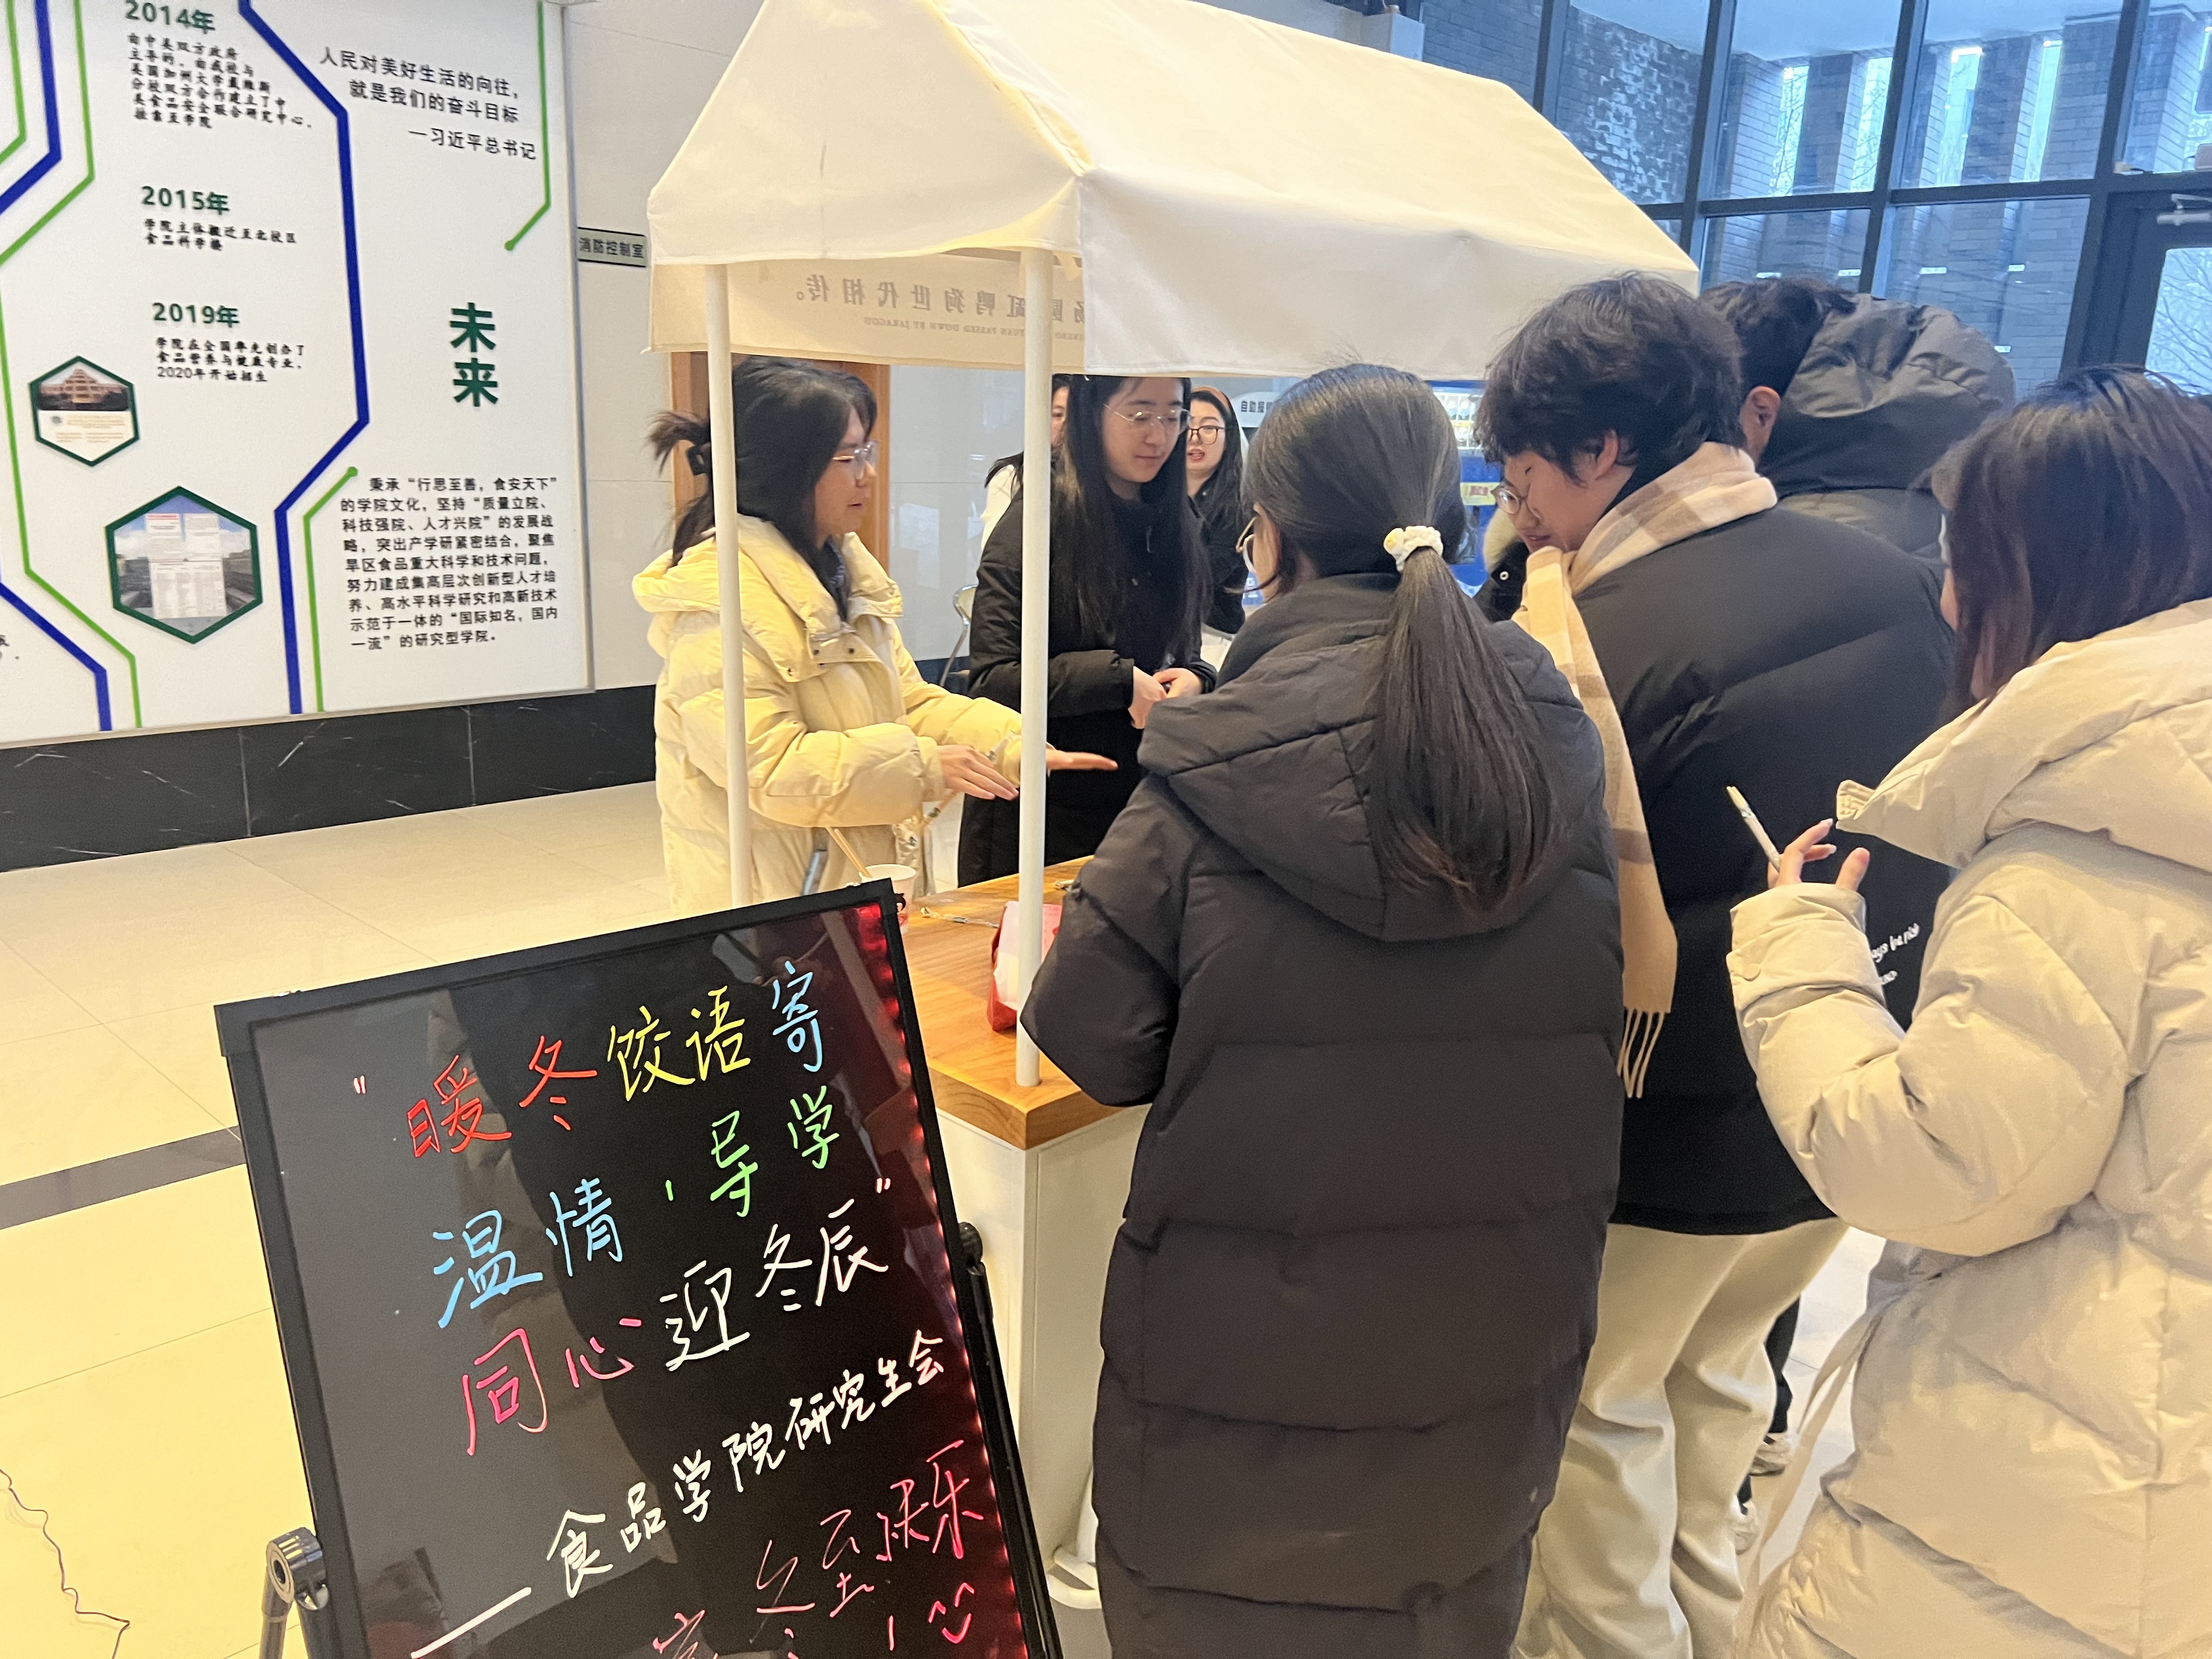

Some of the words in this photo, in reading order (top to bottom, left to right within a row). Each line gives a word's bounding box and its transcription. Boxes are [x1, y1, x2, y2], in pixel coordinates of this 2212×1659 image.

[125, 0, 216, 34] 2014年
[349, 80, 518, 123] 就是我们的奋斗目标
[141, 186, 229, 215] 2015年
[153, 302, 239, 328] 2019年
[450, 302, 499, 407] 未来
[347, 571, 556, 592] 努力建成集高层次创新型人才培
